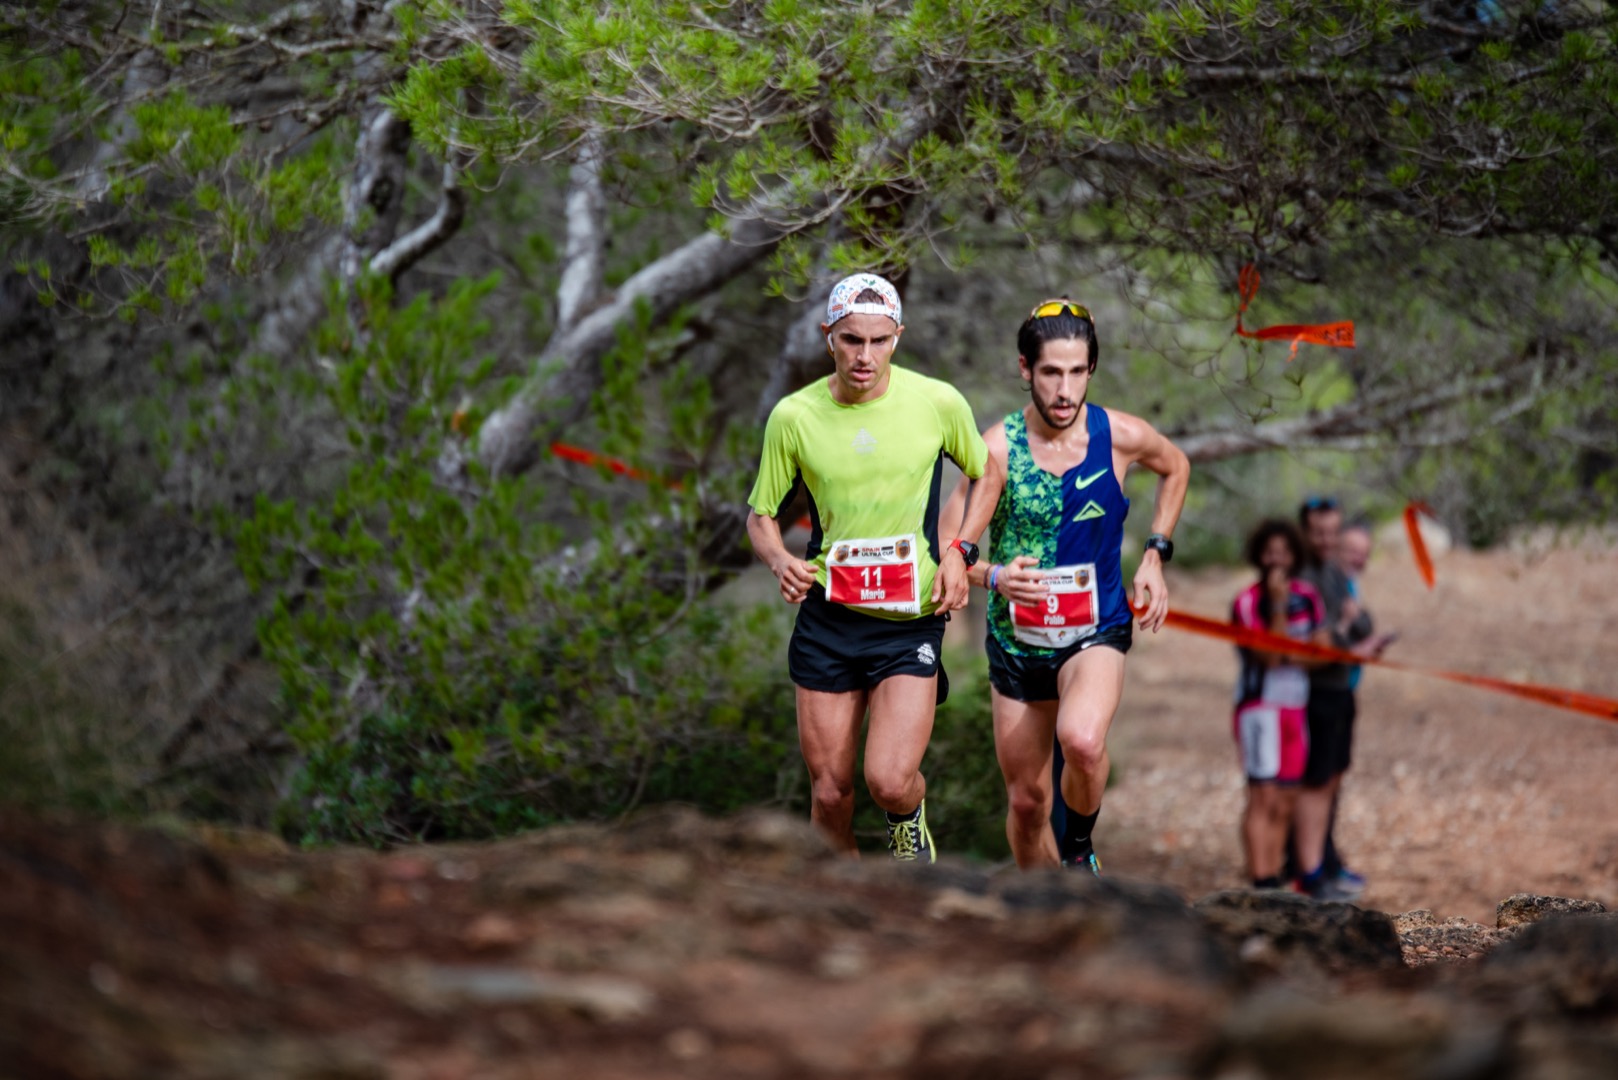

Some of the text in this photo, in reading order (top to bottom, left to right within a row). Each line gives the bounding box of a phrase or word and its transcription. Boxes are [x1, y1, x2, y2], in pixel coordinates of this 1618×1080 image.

[861, 567, 882, 587] 11
[861, 588, 885, 600] Mario
[1047, 594, 1059, 614] 9
[1044, 615, 1066, 626] Pablo
